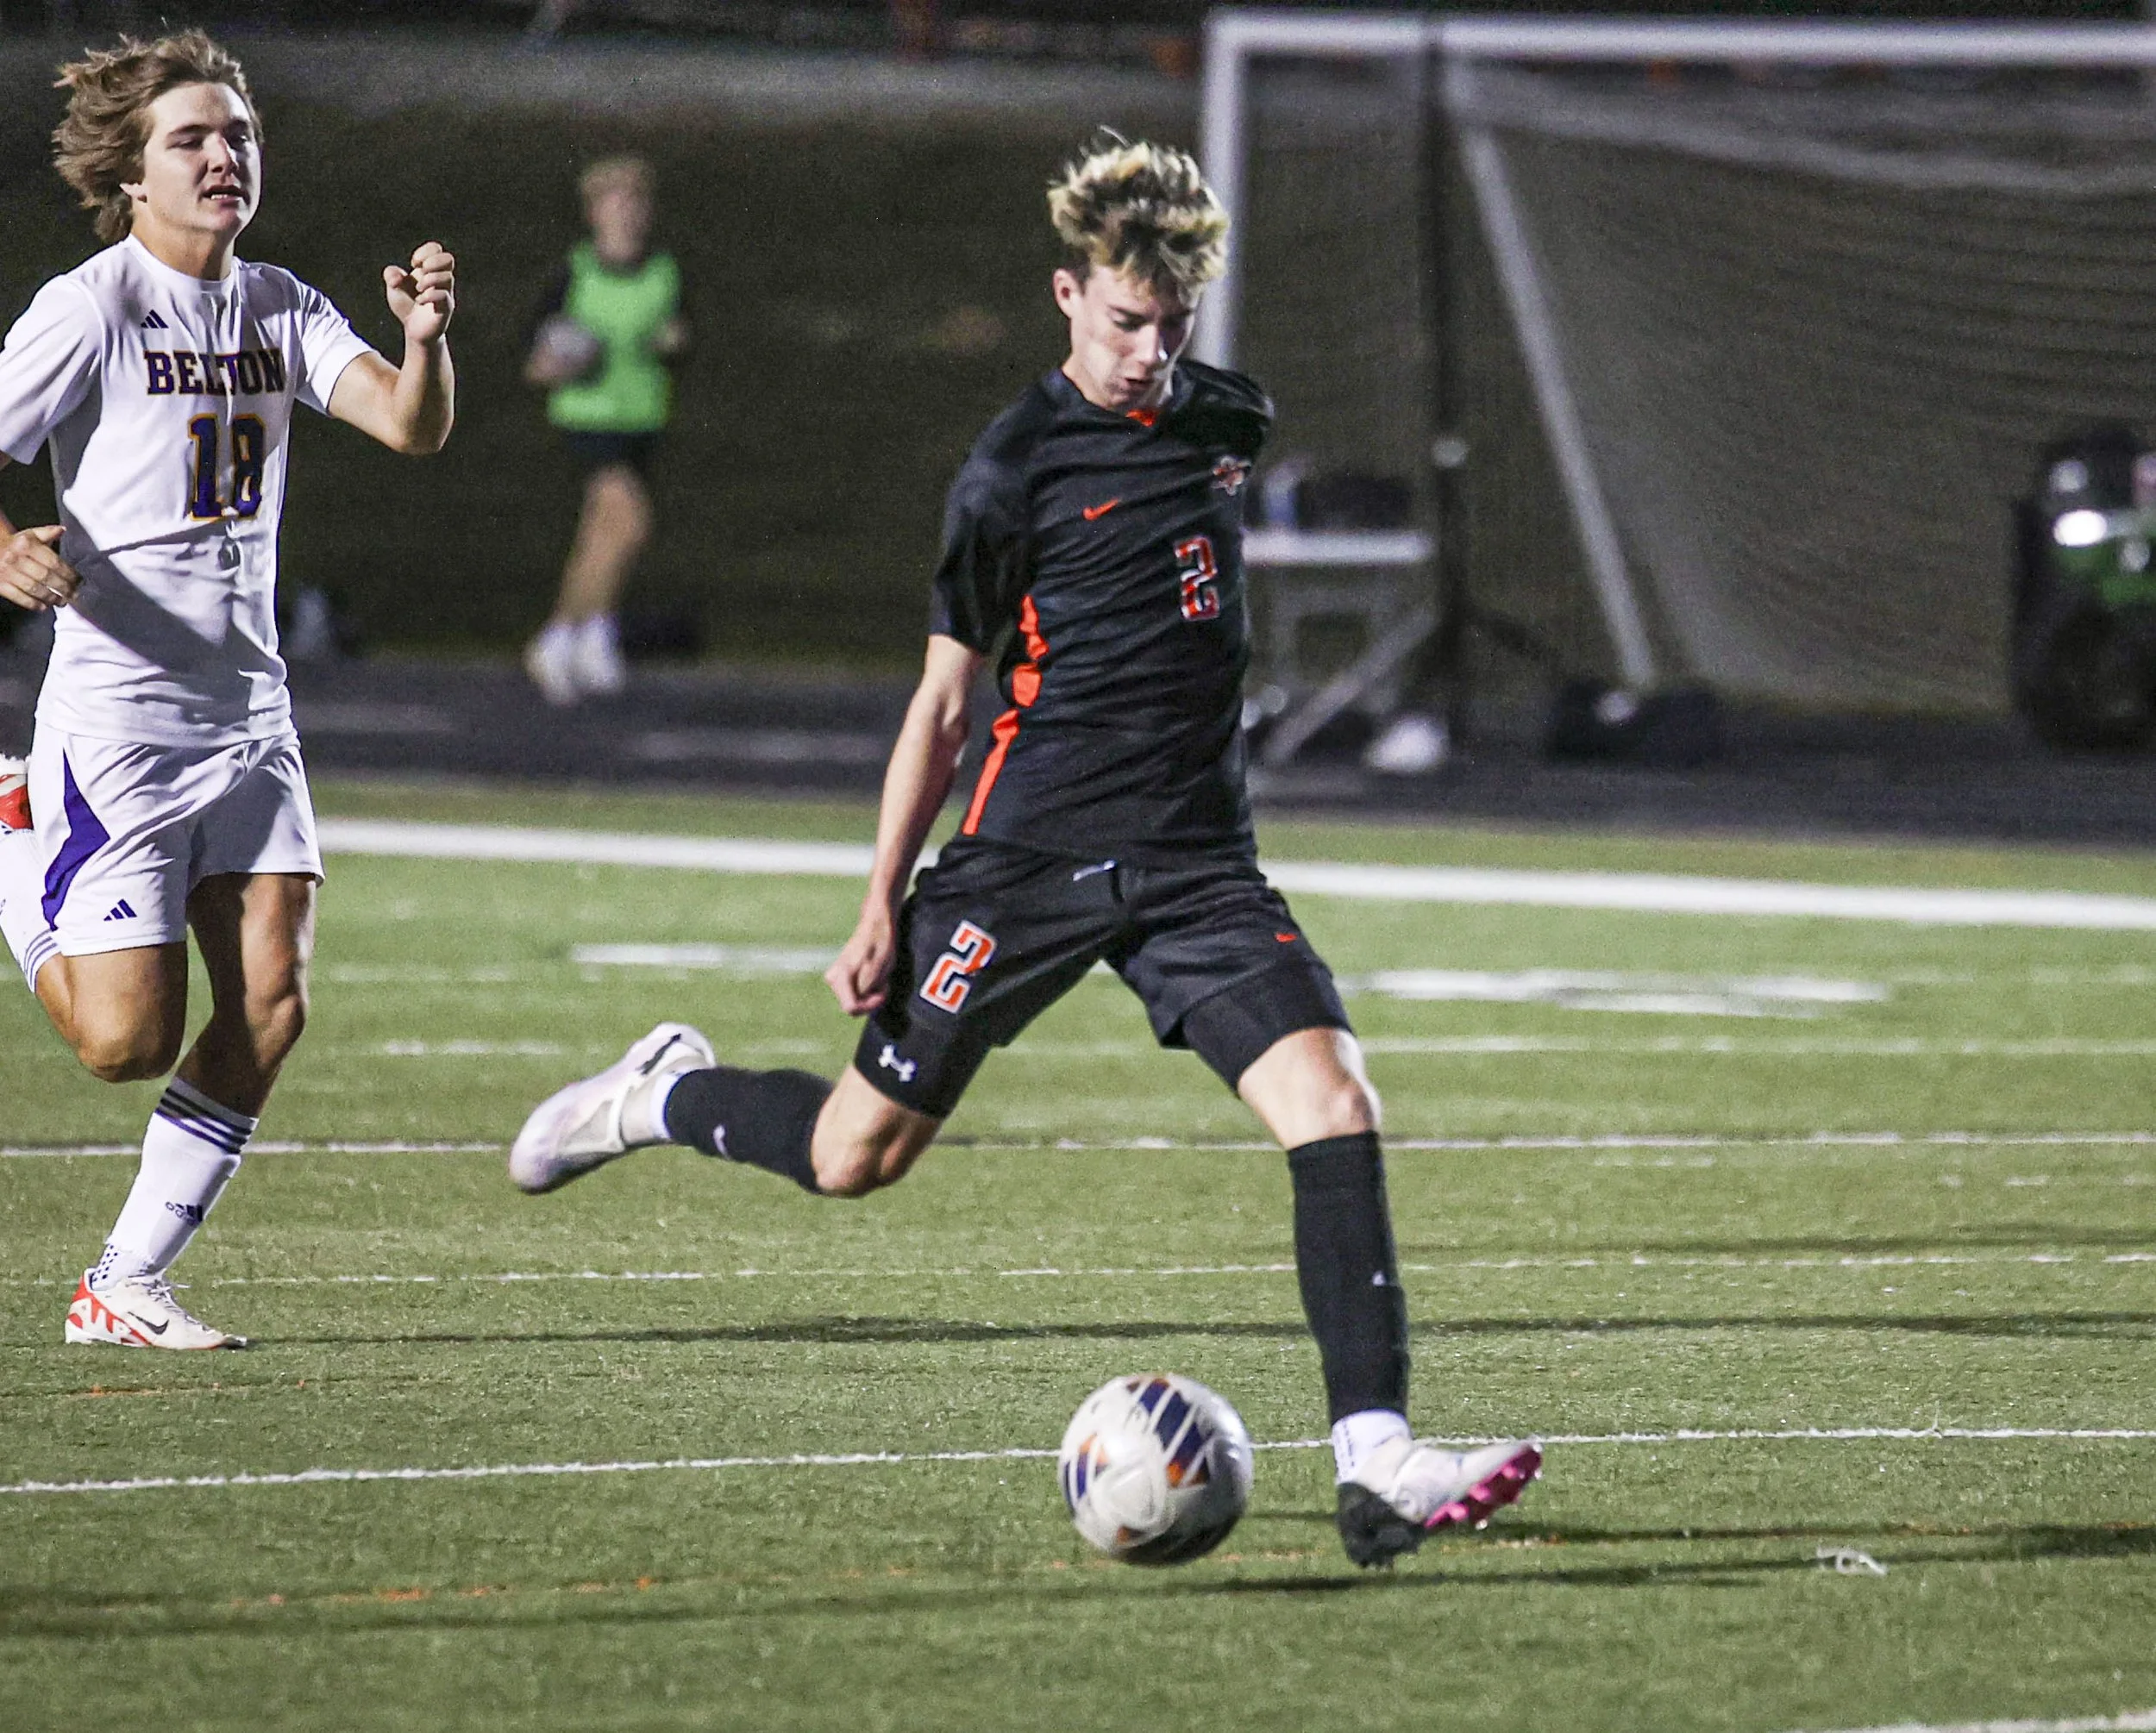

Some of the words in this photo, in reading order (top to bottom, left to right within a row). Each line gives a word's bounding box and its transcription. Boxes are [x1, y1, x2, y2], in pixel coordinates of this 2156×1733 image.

[143, 347, 286, 397] BELTON
[187, 412, 266, 522] 18
[1174, 535, 1220, 622] 2
[918, 919, 998, 1014] 2
